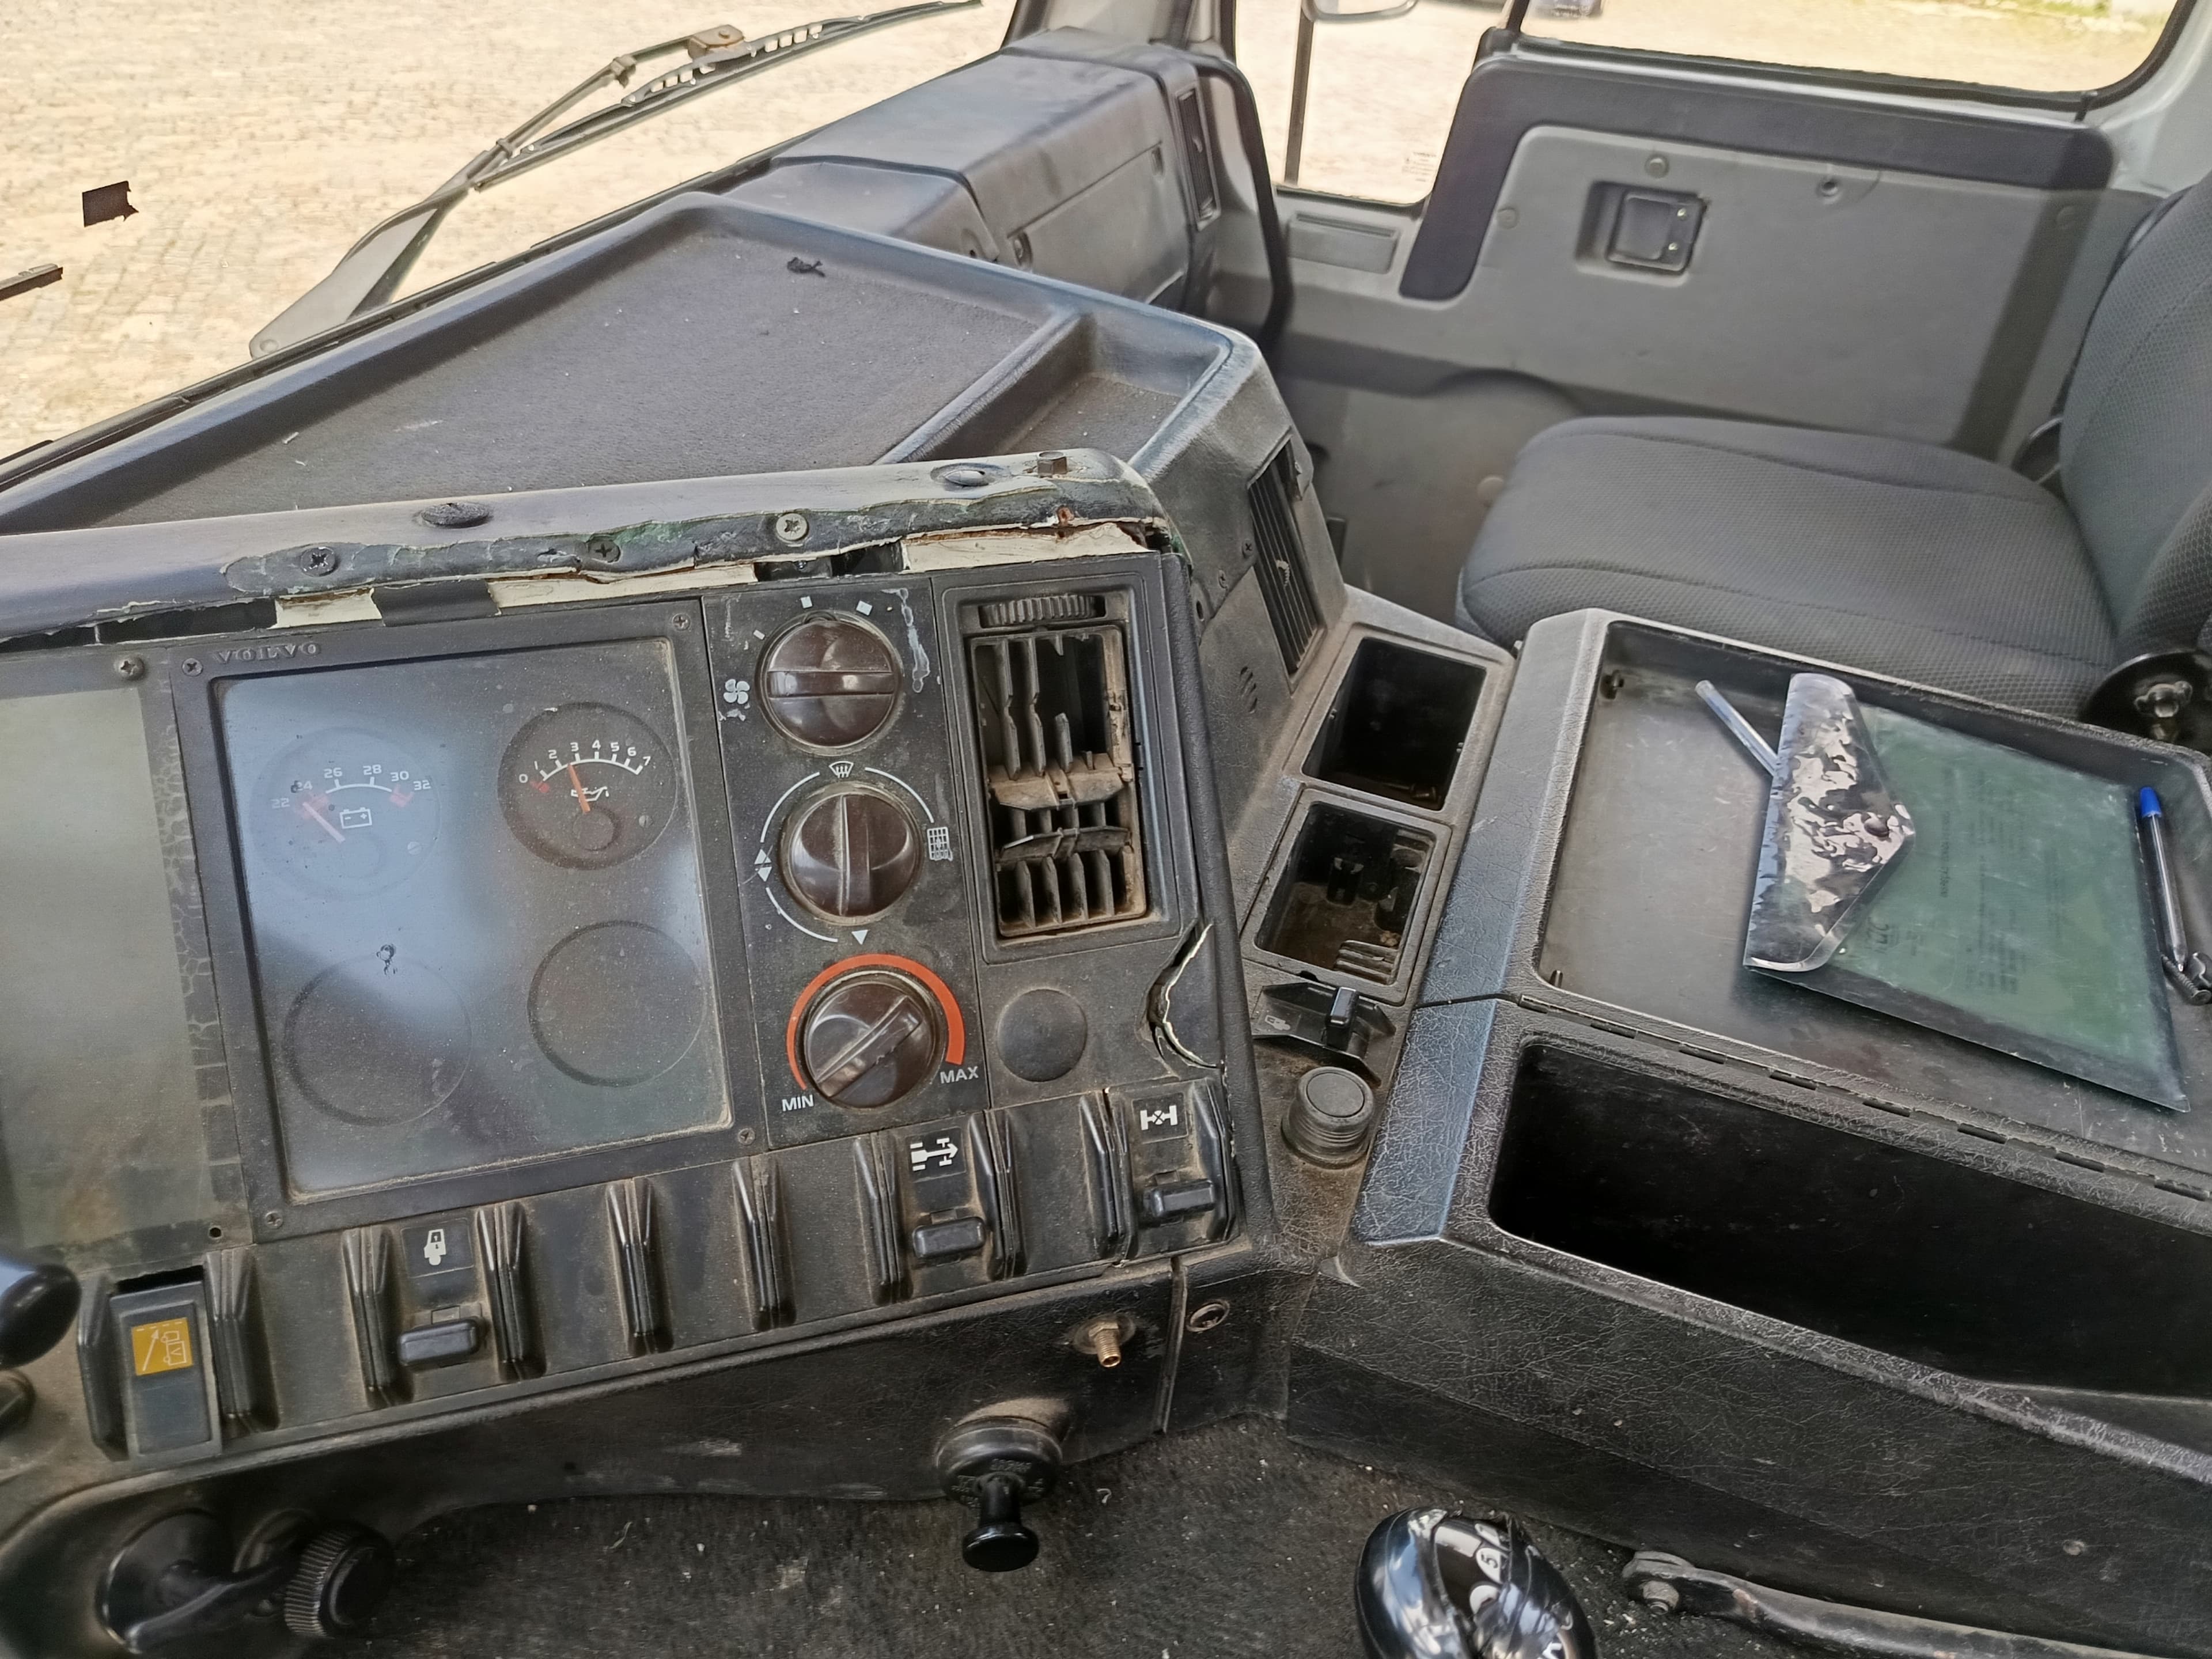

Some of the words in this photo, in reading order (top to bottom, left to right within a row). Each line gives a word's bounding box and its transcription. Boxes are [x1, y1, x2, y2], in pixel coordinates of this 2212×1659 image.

[214, 642, 322, 664] VOLVO
[518, 774, 528, 783] 0
[548, 749, 558, 759] 2
[570, 742, 579, 752] 3
[592, 740, 601, 749] 4
[611, 742, 620, 752] 5
[627, 747, 637, 756] 6
[643, 756, 651, 766] 7
[271, 797, 290, 809] 22
[296, 781, 313, 791] 24
[324, 767, 343, 778] 26
[363, 764, 382, 775] 28
[391, 771, 410, 782] 30
[413, 780, 431, 790] 32
[940, 1066, 979, 1084] MAX
[781, 1094, 814, 1112] MIN
